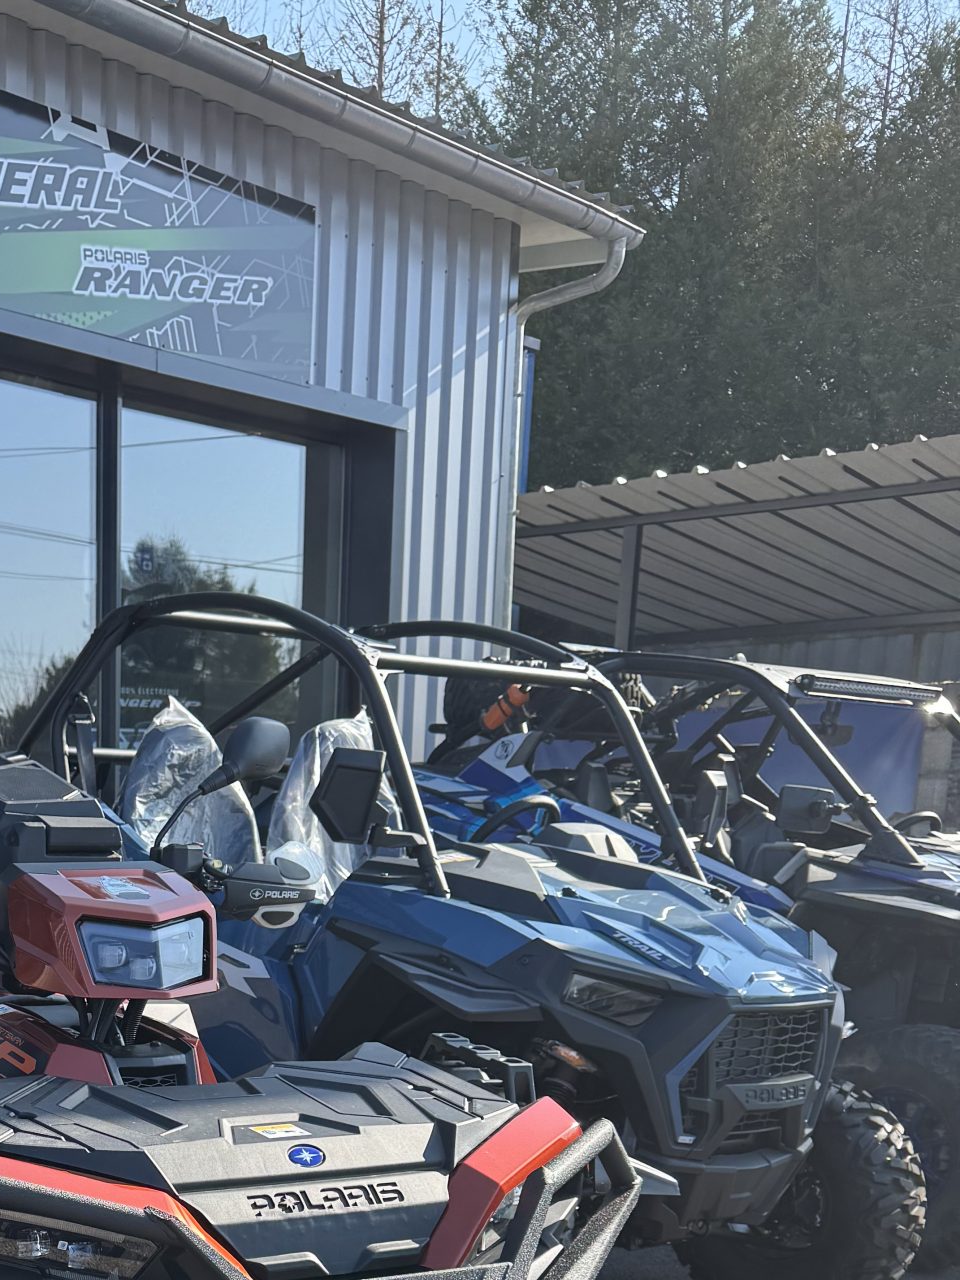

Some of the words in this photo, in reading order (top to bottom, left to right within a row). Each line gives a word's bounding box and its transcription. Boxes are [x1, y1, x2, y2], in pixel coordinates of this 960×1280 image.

[82, 247, 149, 266] POLARIS
[74, 265, 273, 304] RANGER
[264, 890, 300, 899] POLARIS
[612, 930, 663, 961] TRAIL
[744, 1085, 807, 1104] POLARIS
[247, 1182, 405, 1217] POLARIS
